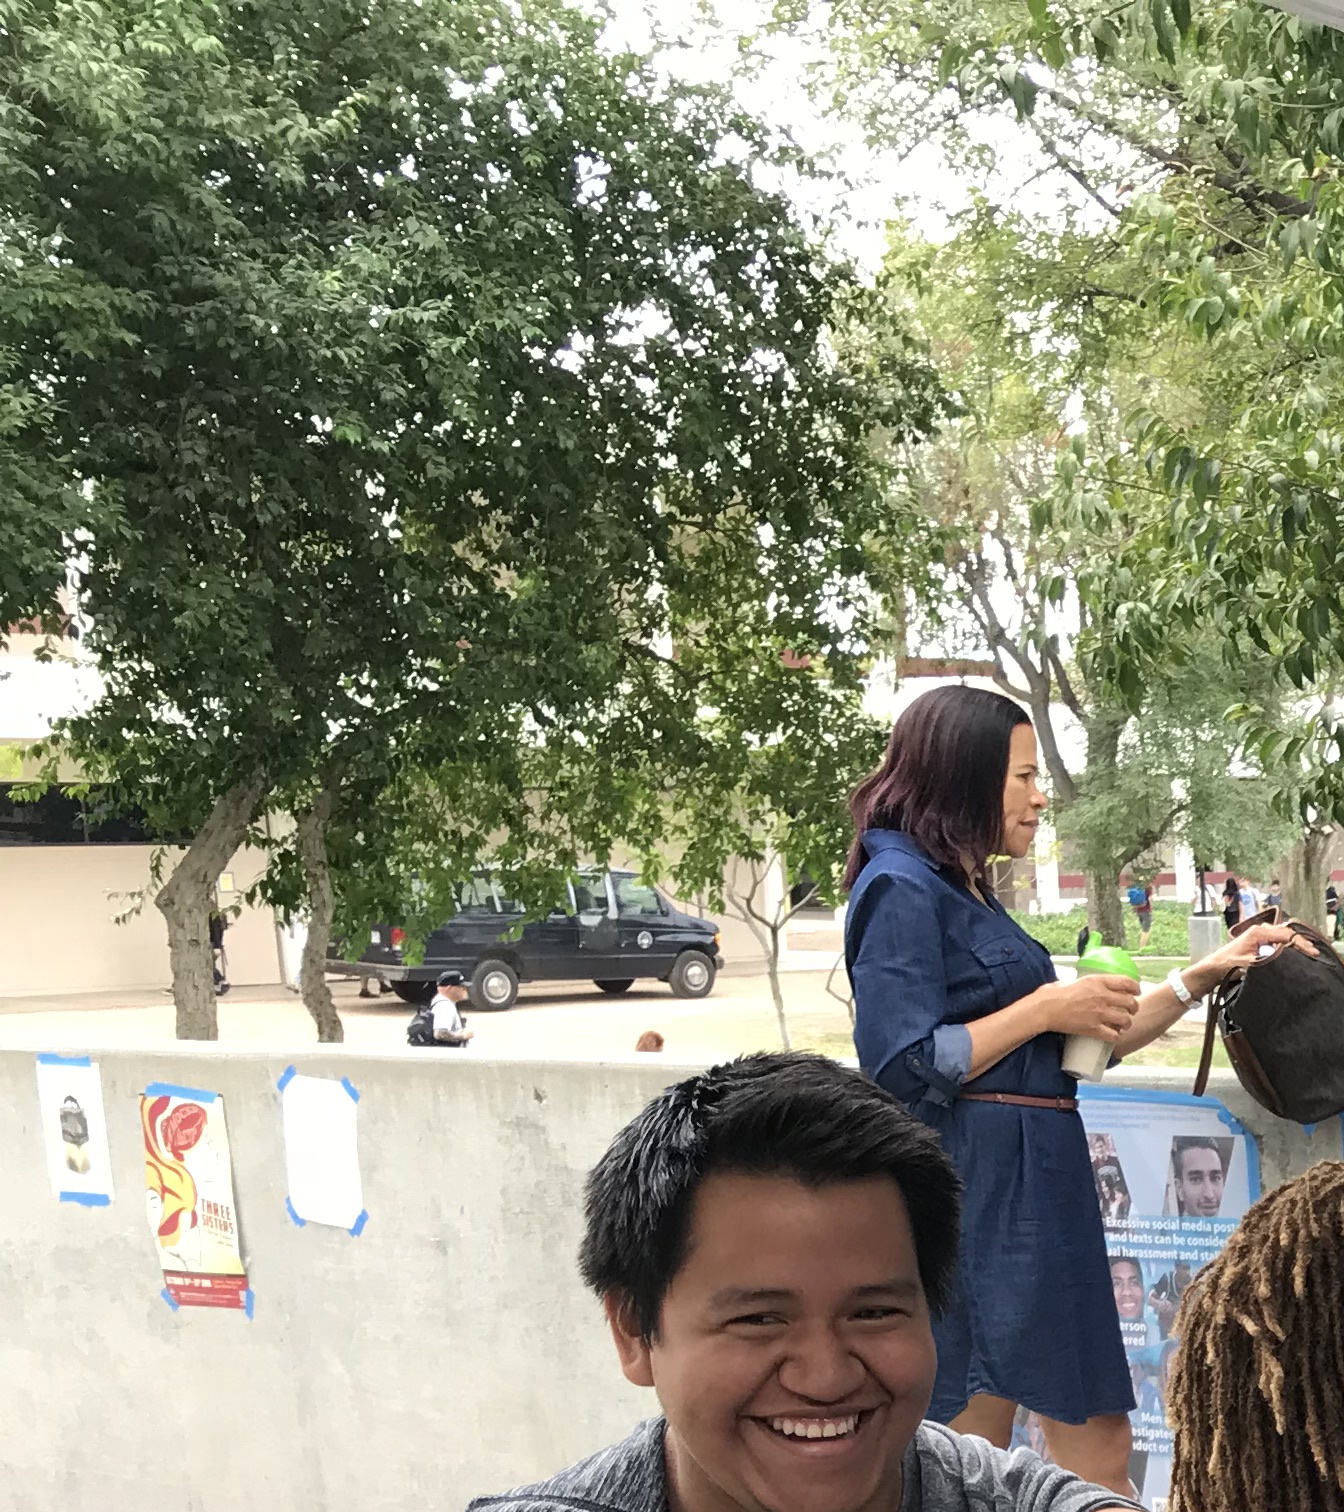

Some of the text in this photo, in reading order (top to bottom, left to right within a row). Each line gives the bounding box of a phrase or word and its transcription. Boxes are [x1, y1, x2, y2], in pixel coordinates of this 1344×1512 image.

[201, 1198, 231, 1220] THREE
[201, 1214, 234, 1234] SISTERS
[1105, 1216, 1151, 1230] Excessive
[1152, 1218, 1180, 1230] social
[1181, 1219, 1212, 1232] media
[1108, 1231, 1228, 1247] and texts can be conside
[1122, 1245, 1179, 1260] harassment
[1180, 1249, 1198, 1260] and
[1120, 1321, 1147, 1332] erson
[1141, 1411, 1162, 1424] Men
